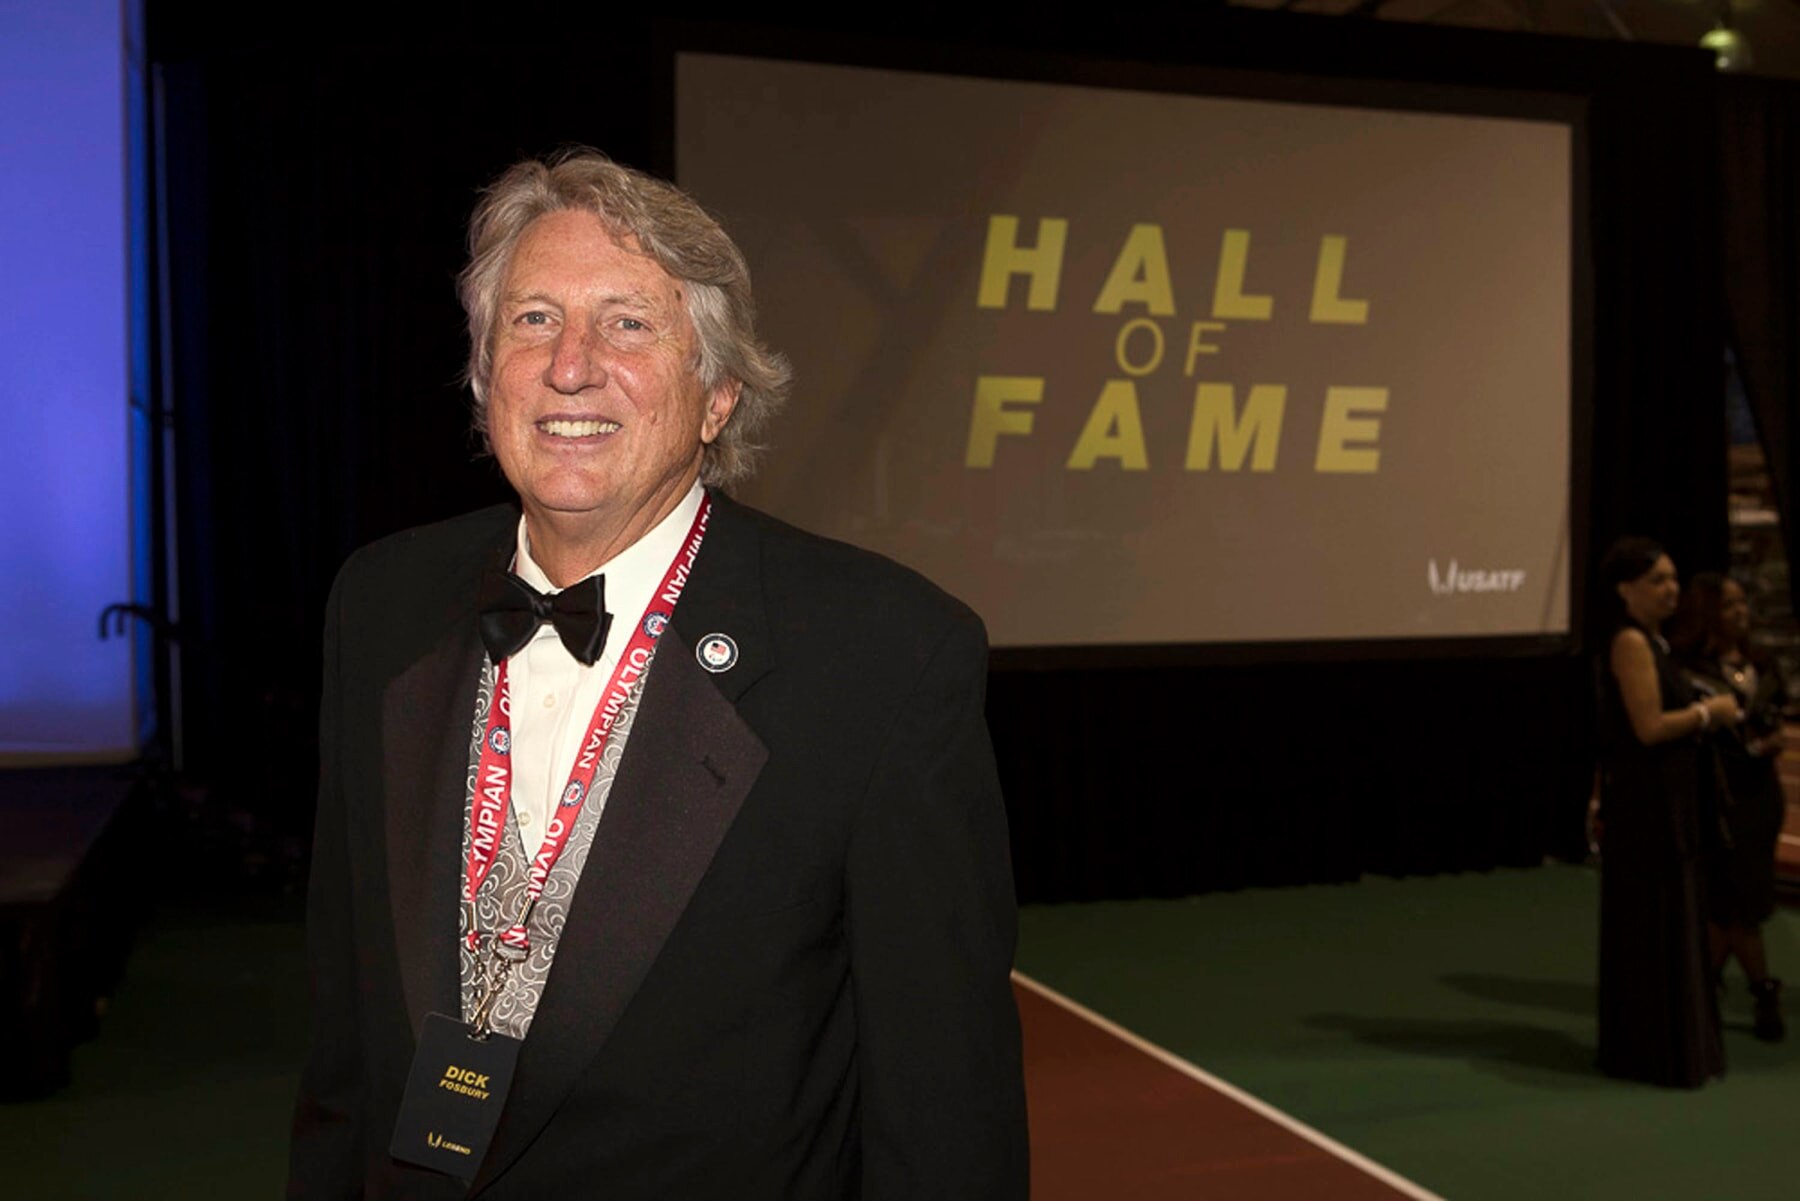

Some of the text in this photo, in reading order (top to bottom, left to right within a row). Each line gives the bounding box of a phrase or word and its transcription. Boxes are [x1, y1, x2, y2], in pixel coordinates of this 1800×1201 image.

[977, 214, 1370, 325] HALL
[1115, 317, 1226, 377] OF
[965, 376, 1390, 474] FAME
[578, 647, 649, 770] OLYMPIAN
[439, 1079, 490, 1100] FOSBURY
[445, 1065, 490, 1089] DICK
